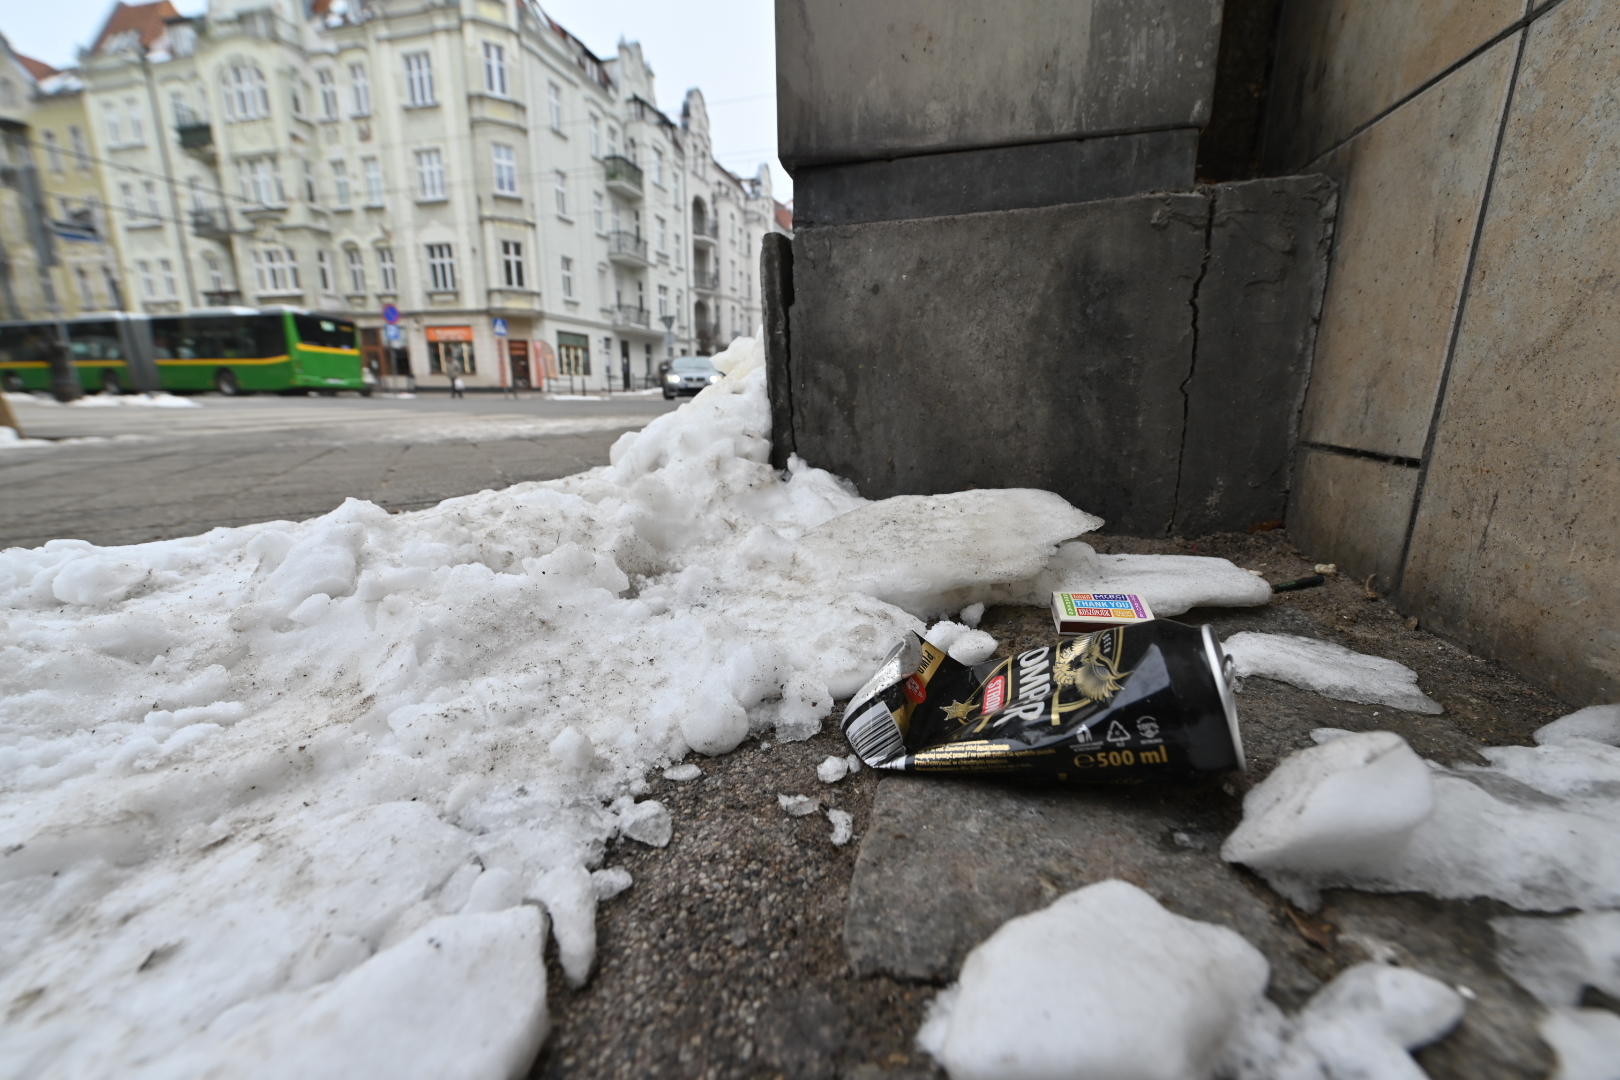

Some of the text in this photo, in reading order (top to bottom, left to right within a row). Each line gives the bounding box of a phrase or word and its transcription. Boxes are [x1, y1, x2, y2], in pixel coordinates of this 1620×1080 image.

[1075, 600, 1130, 609] THANK YOU
[984, 679, 1002, 714] STRON
[993, 647, 1051, 728] OMPR
[1096, 749, 1136, 768] 500
[1139, 744, 1169, 764] ml
